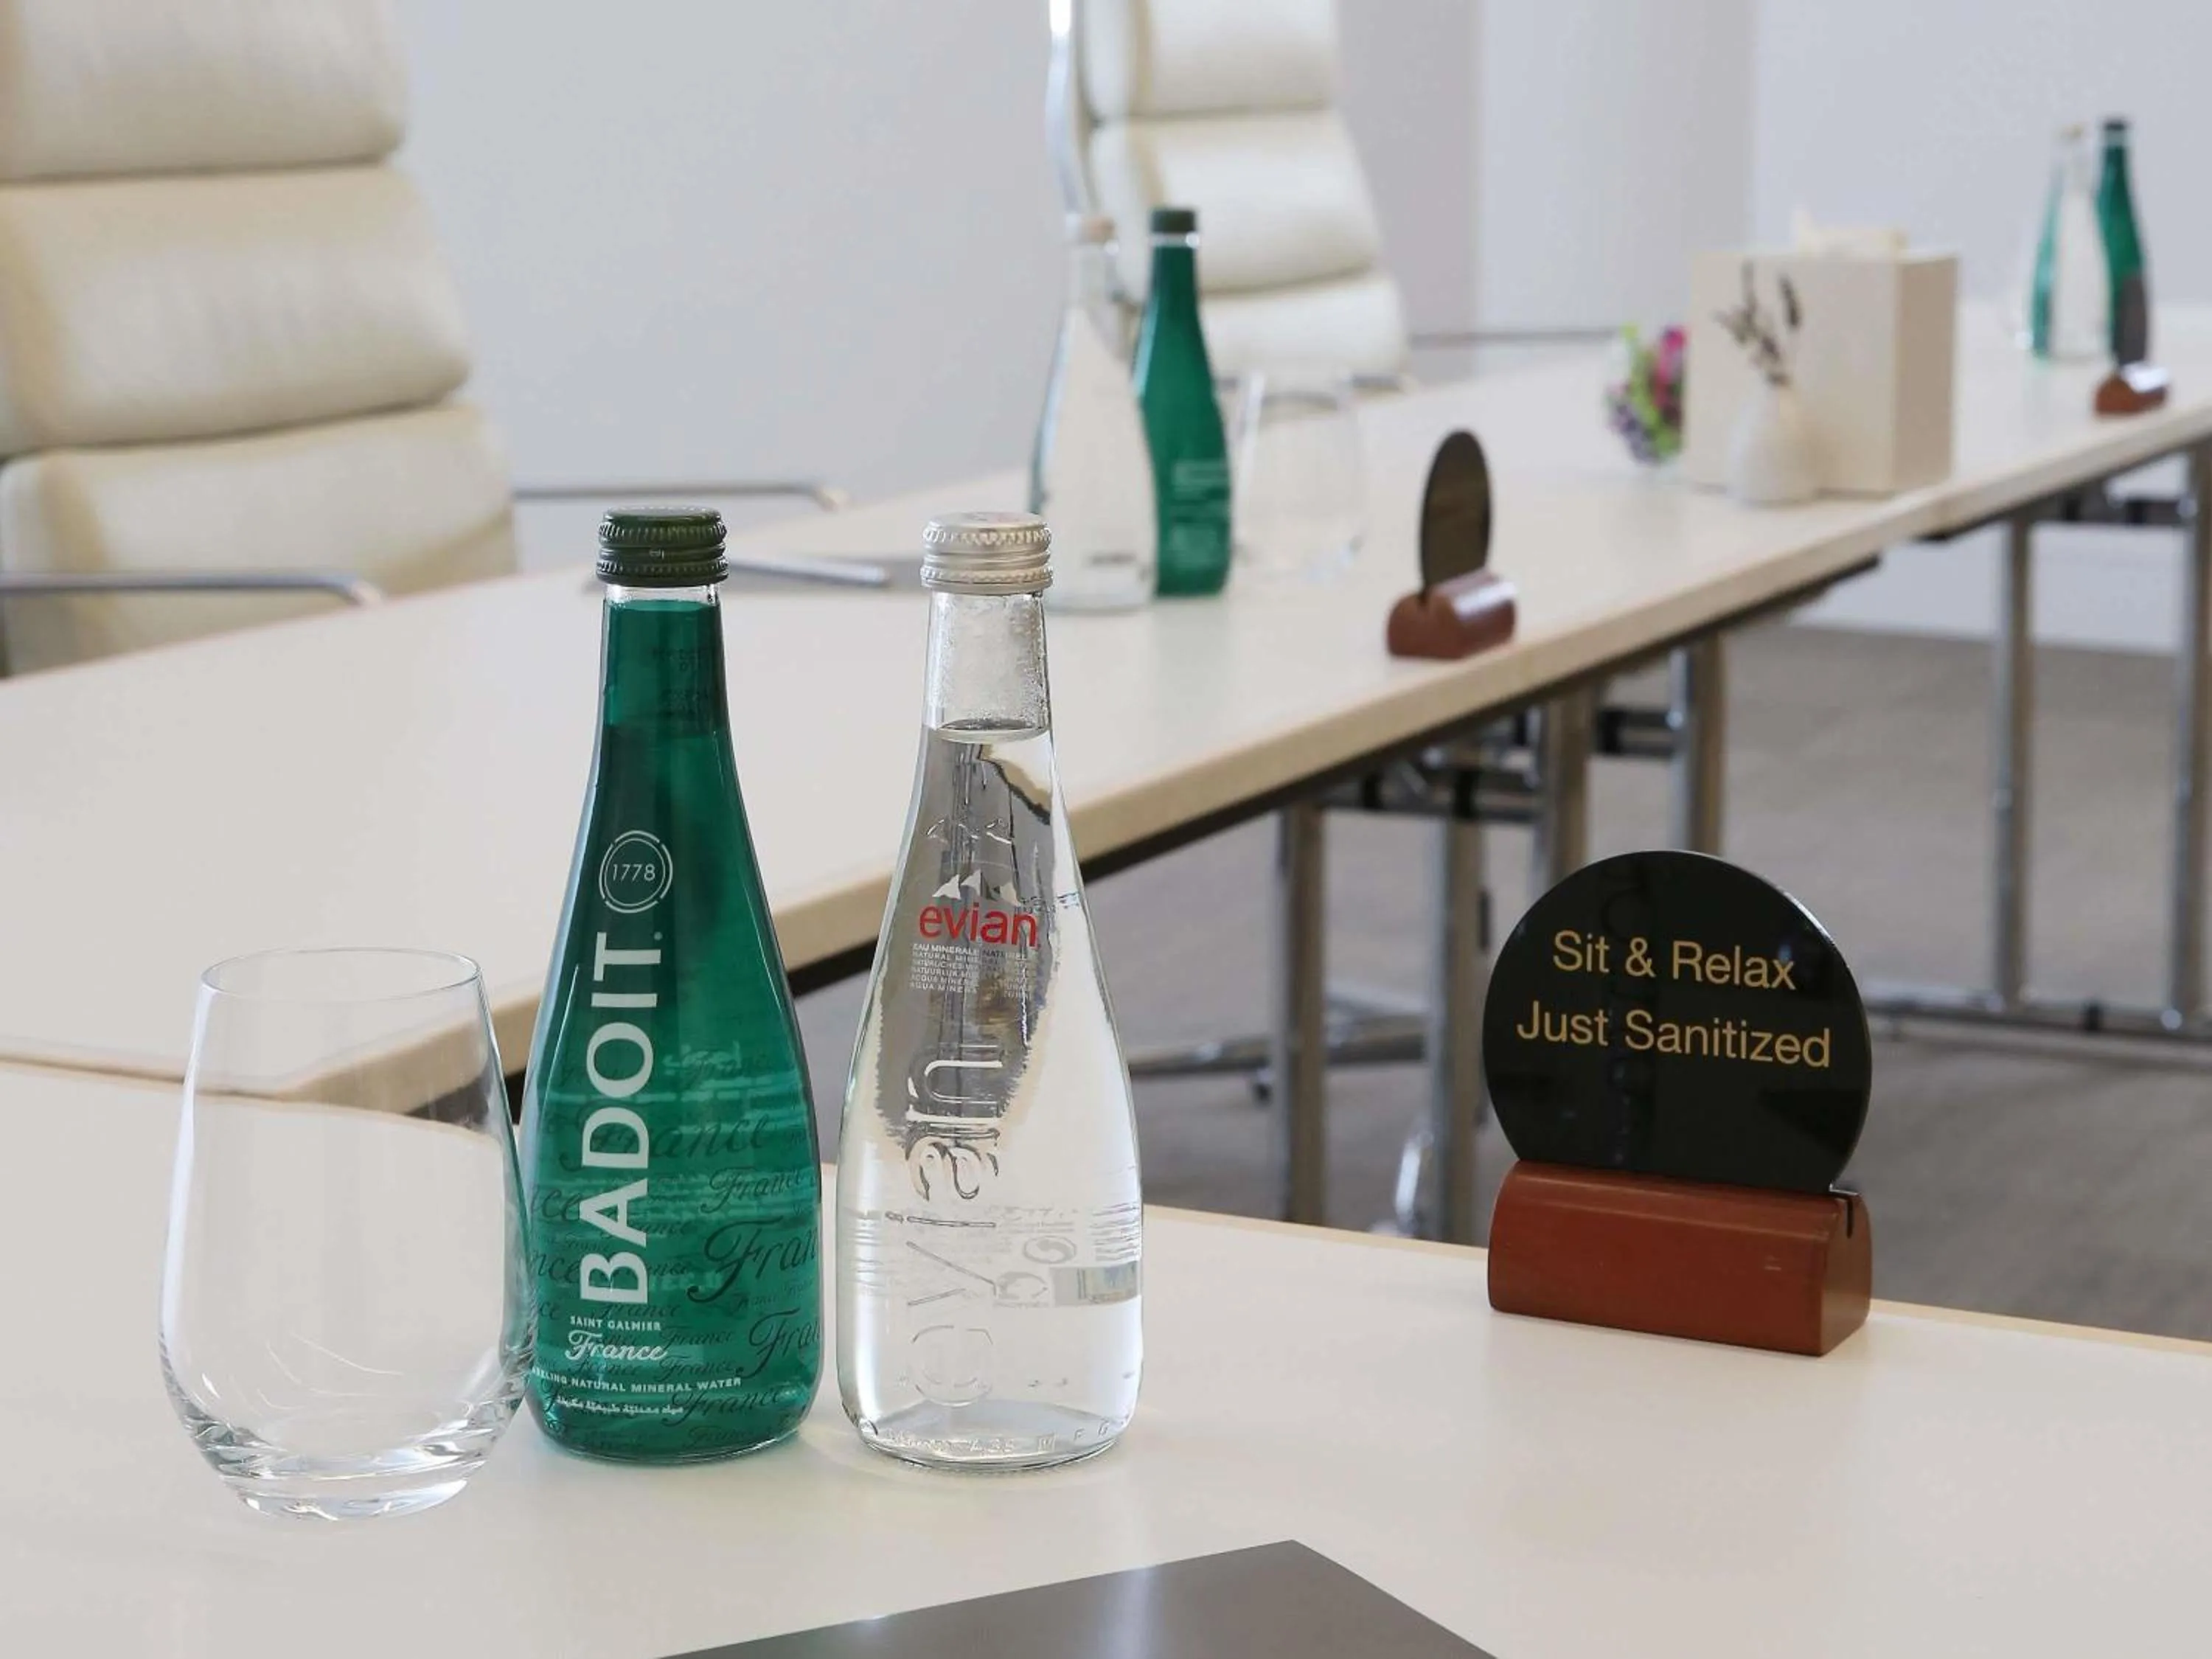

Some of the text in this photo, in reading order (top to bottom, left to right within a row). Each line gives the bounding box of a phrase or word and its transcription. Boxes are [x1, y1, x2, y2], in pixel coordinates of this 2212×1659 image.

[612, 863, 656, 882] 1778
[919, 902, 1037, 947] evian
[1553, 929, 1796, 990] Sit & Relax
[1517, 1000, 1831, 1068] Just Sanitized
[580, 931, 662, 1304] BADOIT
[570, 1315, 661, 1332] SAINT GALMIER
[565, 1329, 668, 1361] France
[571, 1377, 627, 1393] NATURAL
[630, 1382, 692, 1394] MINERAL
[696, 1376, 742, 1391] WATER
